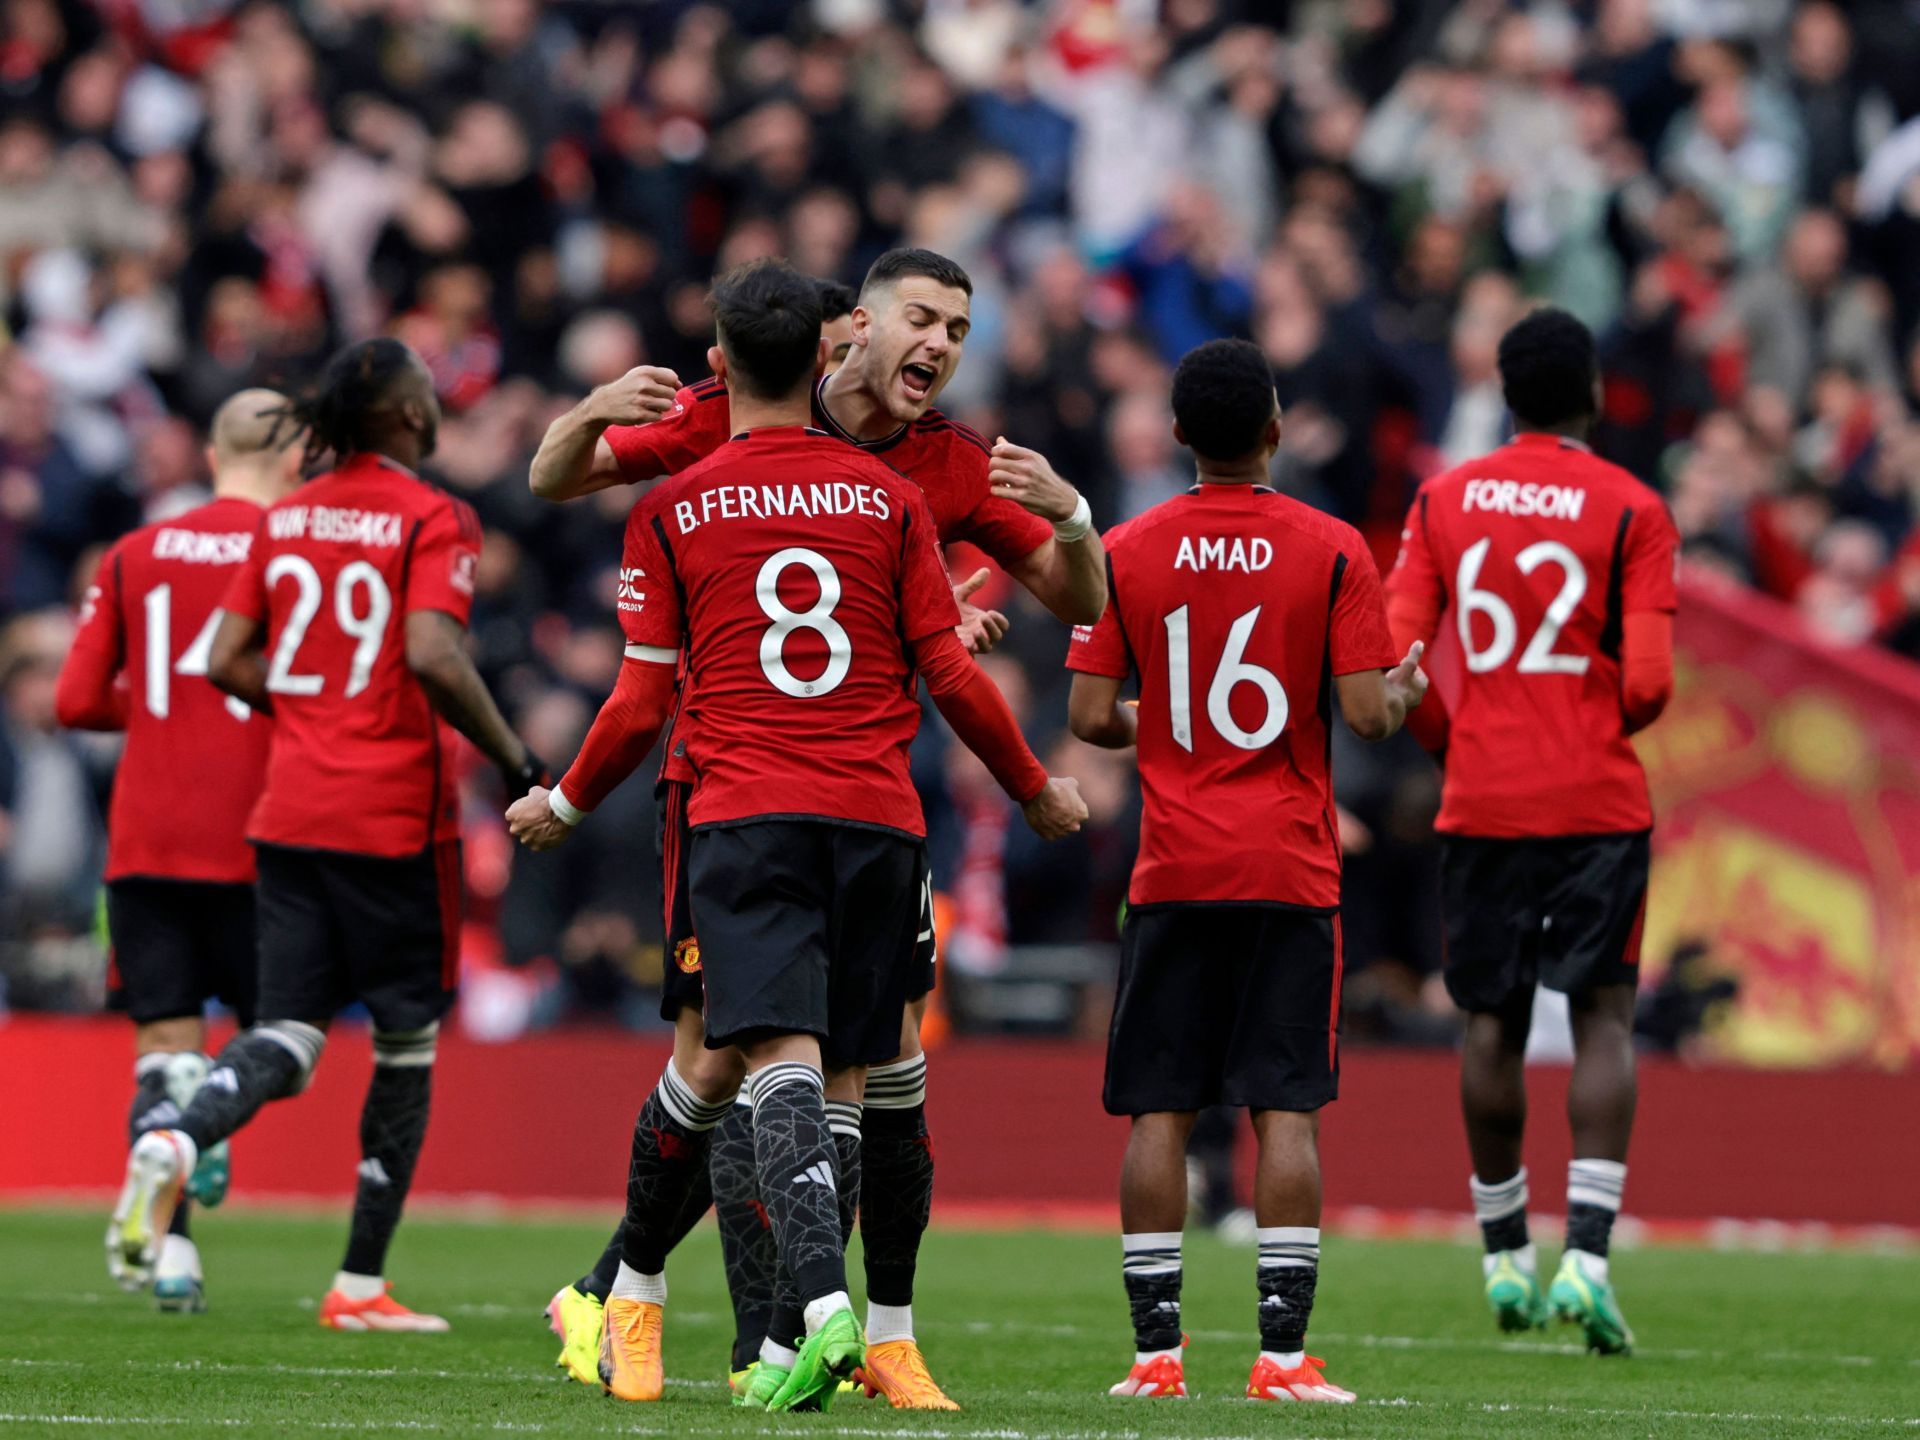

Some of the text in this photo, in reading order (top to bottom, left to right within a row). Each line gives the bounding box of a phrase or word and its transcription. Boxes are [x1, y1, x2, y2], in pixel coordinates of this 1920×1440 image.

[674, 482, 890, 535] B.FERNANDES
[1173, 535, 1274, 574] AMAD
[1461, 478, 1586, 521] FORSON
[265, 553, 392, 698] 29
[755, 547, 852, 698] 8
[1456, 537, 1590, 675] 62
[1163, 604, 1289, 753] 16
